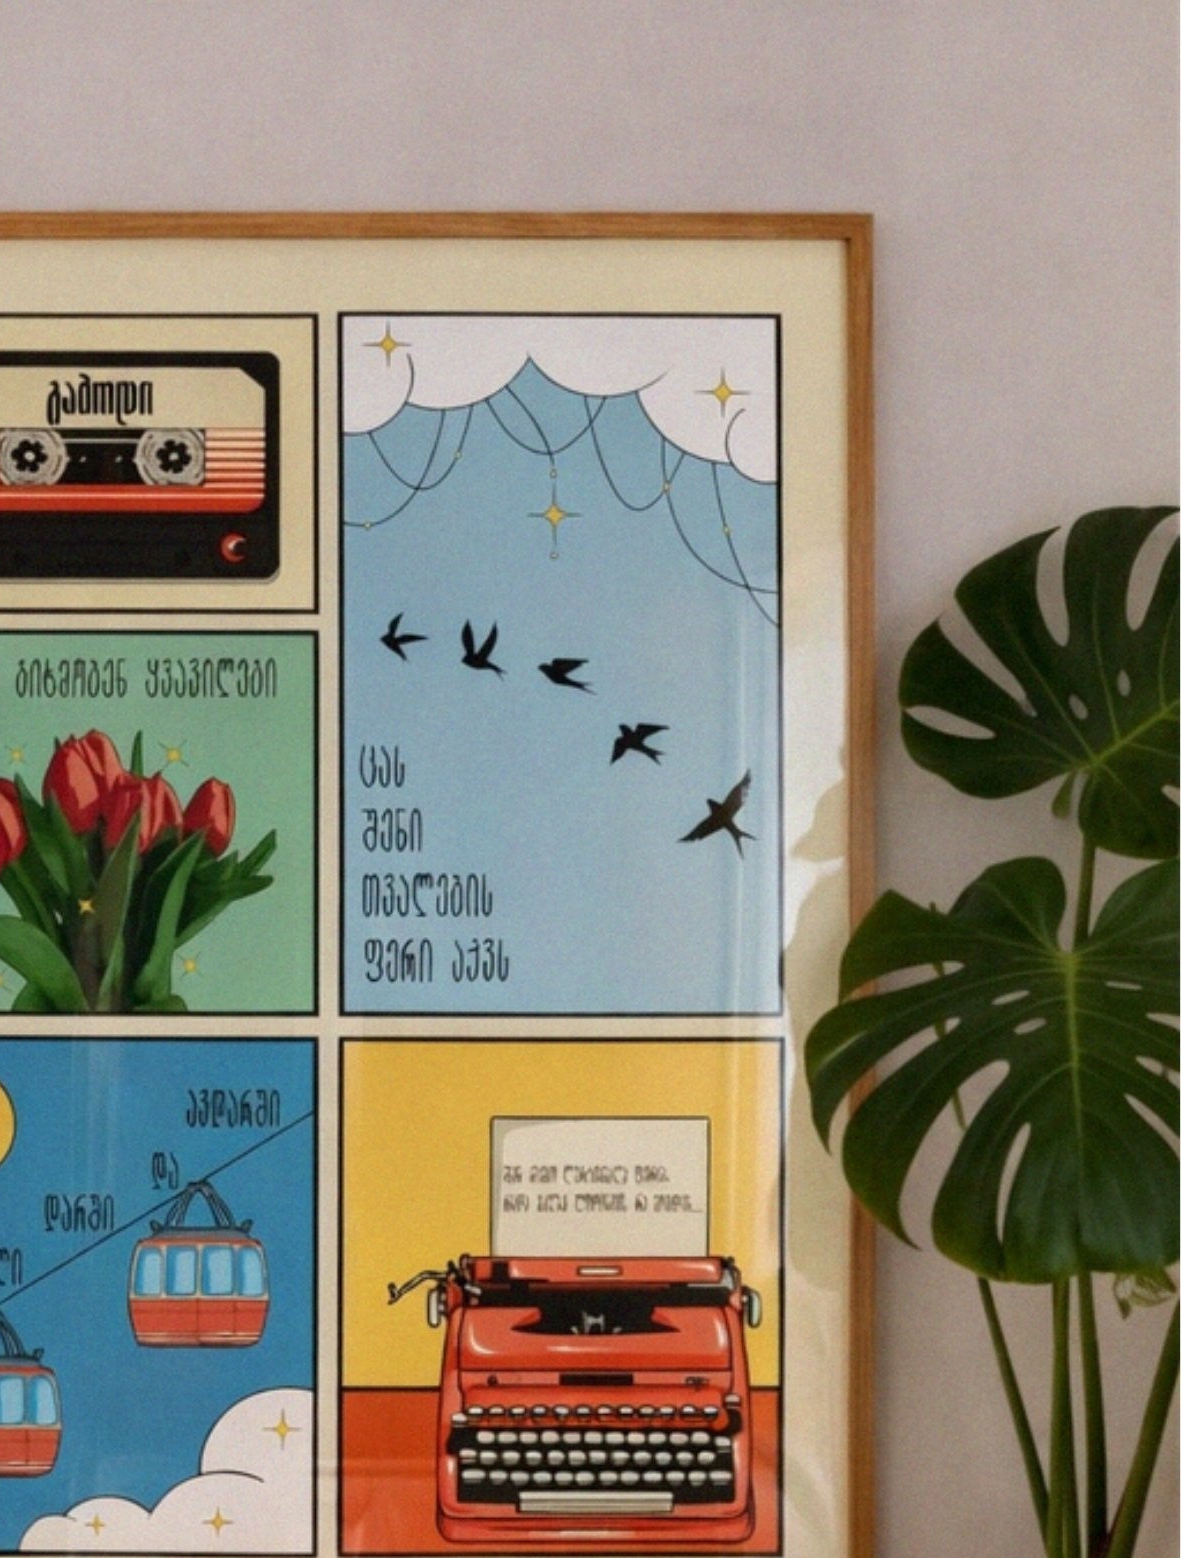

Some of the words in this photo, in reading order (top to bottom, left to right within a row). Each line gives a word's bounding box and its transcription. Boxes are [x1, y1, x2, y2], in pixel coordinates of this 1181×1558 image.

[359, 744, 406, 789] ცას
[361, 807, 423, 853] შენი
[361, 872, 494, 918] თვალების
[363, 937, 433, 984] ფერი
[451, 937, 510, 984] აქვს
